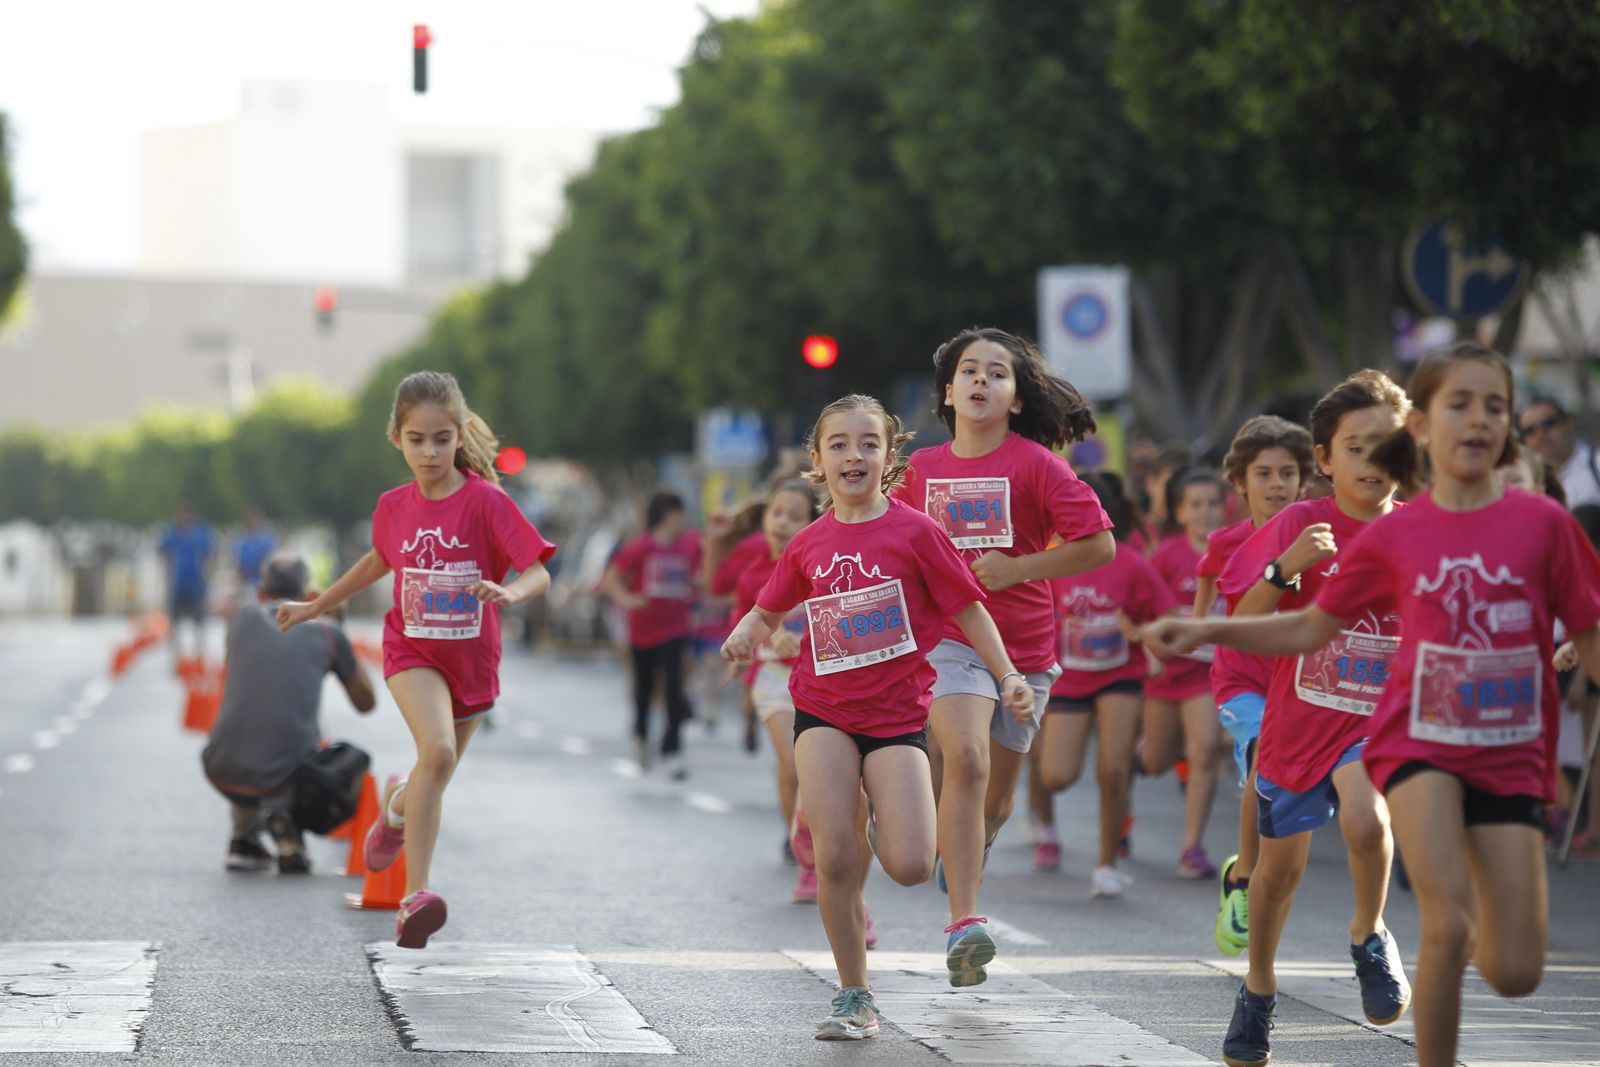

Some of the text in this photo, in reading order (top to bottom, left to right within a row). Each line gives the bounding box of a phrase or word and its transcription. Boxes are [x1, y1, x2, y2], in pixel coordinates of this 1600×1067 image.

[946, 499, 1001, 522] 1851
[422, 592, 478, 612] 1645
[844, 594, 868, 604] CARRERA
[868, 586, 897, 600] SOLIDARIA
[838, 605, 904, 639] 1992
[1335, 655, 1392, 685] 155
[1337, 680, 1361, 692] JORGE
